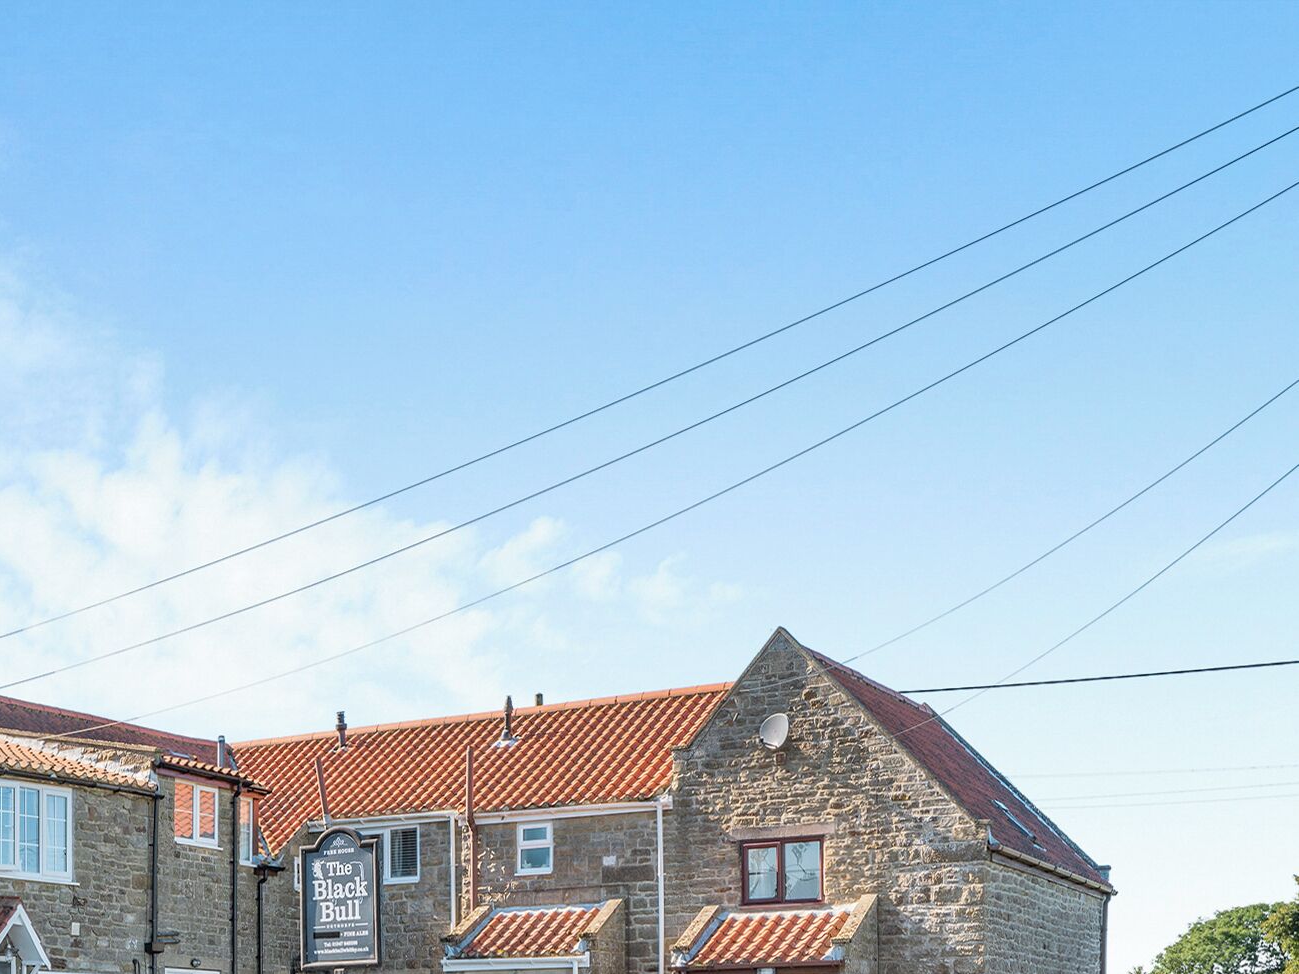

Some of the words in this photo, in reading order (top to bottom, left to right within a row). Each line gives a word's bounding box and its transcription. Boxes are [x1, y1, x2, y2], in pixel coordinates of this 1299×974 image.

[326, 861, 353, 877] The
[312, 876, 368, 901] Black
[319, 900, 361, 922] Bull
